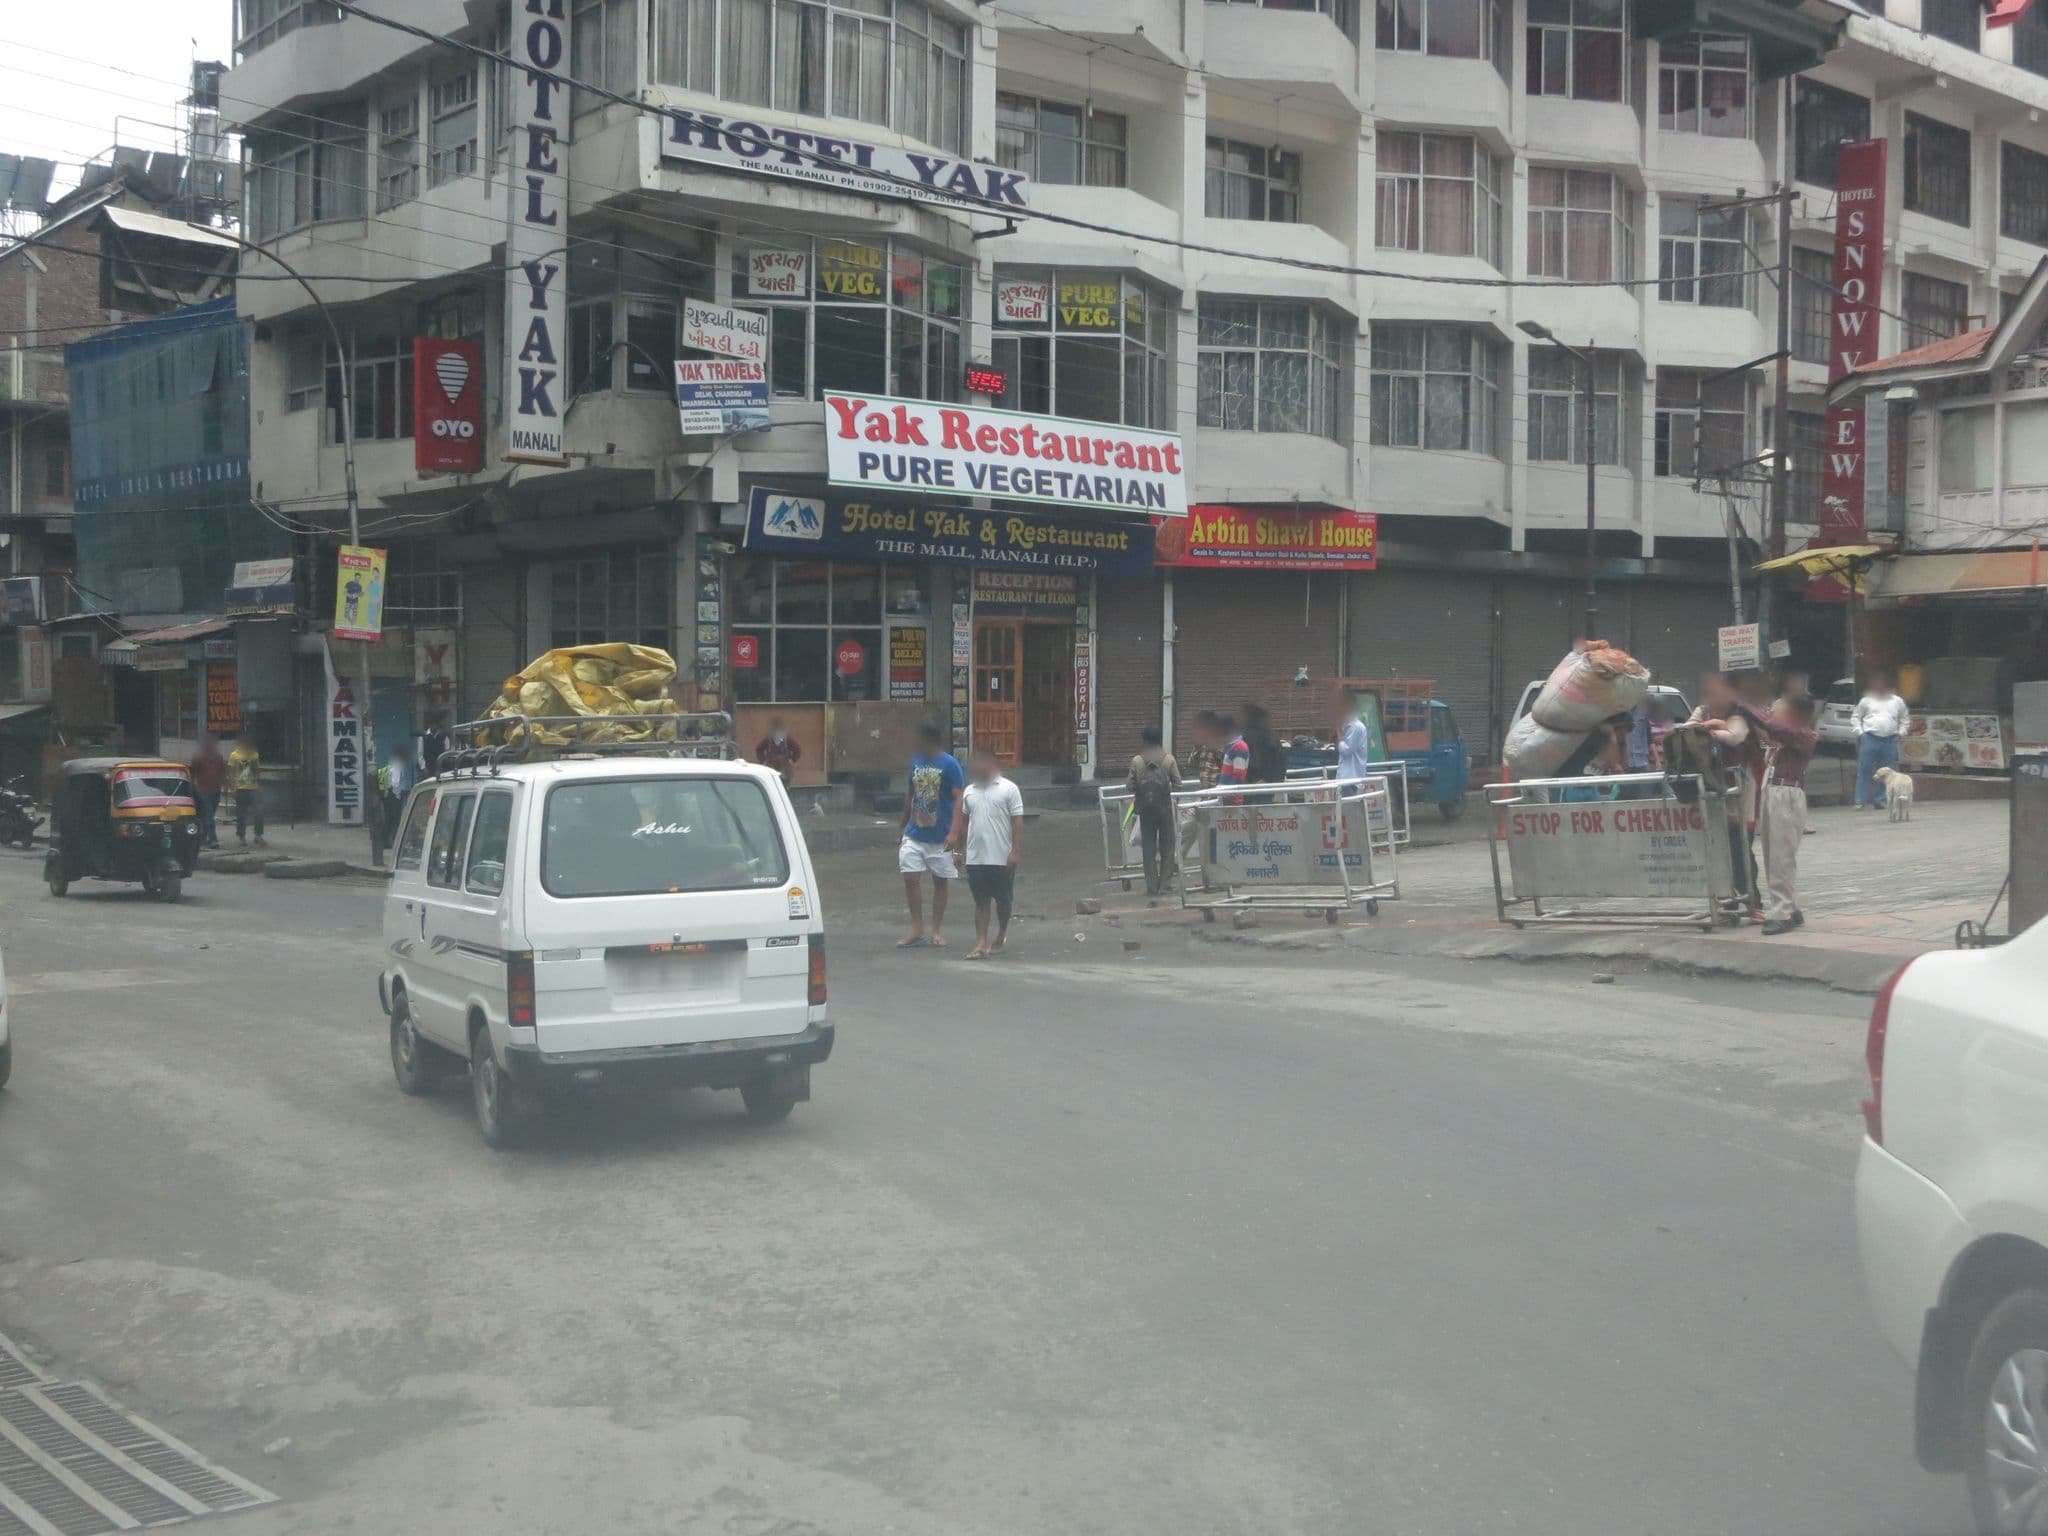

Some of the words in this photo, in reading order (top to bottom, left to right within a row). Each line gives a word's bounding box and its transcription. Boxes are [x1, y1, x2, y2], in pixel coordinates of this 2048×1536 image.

[669, 108, 891, 179] HOTEL
[905, 153, 1026, 206] YAK
[740, 159, 760, 170] THE
[764, 164, 792, 176] MALL
[795, 169, 835, 183] MANALI
[863, 181, 892, 194] 01902
[1840, 188, 1876, 202] HOTEL
[822, 246, 881, 269] PURE
[822, 271, 881, 296] VEG.
[1060, 285, 1116, 305] PURE
[1059, 306, 1116, 327] VEG.
[518, 260, 558, 418] YAK
[679, 362, 704, 381] YAK
[706, 362, 762, 381] TRAVELS
[432, 420, 474, 438] OYO
[827, 396, 929, 446] Yak
[938, 409, 1182, 475] Restaurant
[512, 430, 561, 453] MANALI
[858, 451, 955, 488] PURE
[964, 461, 1167, 509] VEGETARIAN
[841, 503, 916, 533] Hotel
[923, 511, 972, 538] Yak
[980, 518, 998, 546] &
[1006, 517, 1129, 550] Restaurant
[1189, 514, 1250, 545] Arbin
[1255, 516, 1315, 546] Shawl
[1320, 519, 1374, 548] House
[875, 539, 915, 554] THE
[920, 543, 976, 560] MALL,
[980, 548, 1050, 564] MANALI
[1054, 554, 1098, 569] (H.P.)
[978, 571, 1075, 590] RECEPTION
[973, 589, 1033, 603] RESTAURANT
[1048, 592, 1076, 605] FLOOR
[1721, 629, 1737, 637] ONE
[1738, 626, 1755, 635] WAY
[1722, 636, 1753, 647] TRAFFIC
[1079, 669, 1087, 728] BOOKING
[333, 721, 359, 820] MARKET
[631, 822, 693, 837] Ashu
[1512, 812, 1561, 835] STOP
[1571, 810, 1604, 833] FOR
[1614, 807, 1705, 833] CHEKING
[767, 938, 799, 947] Omni
